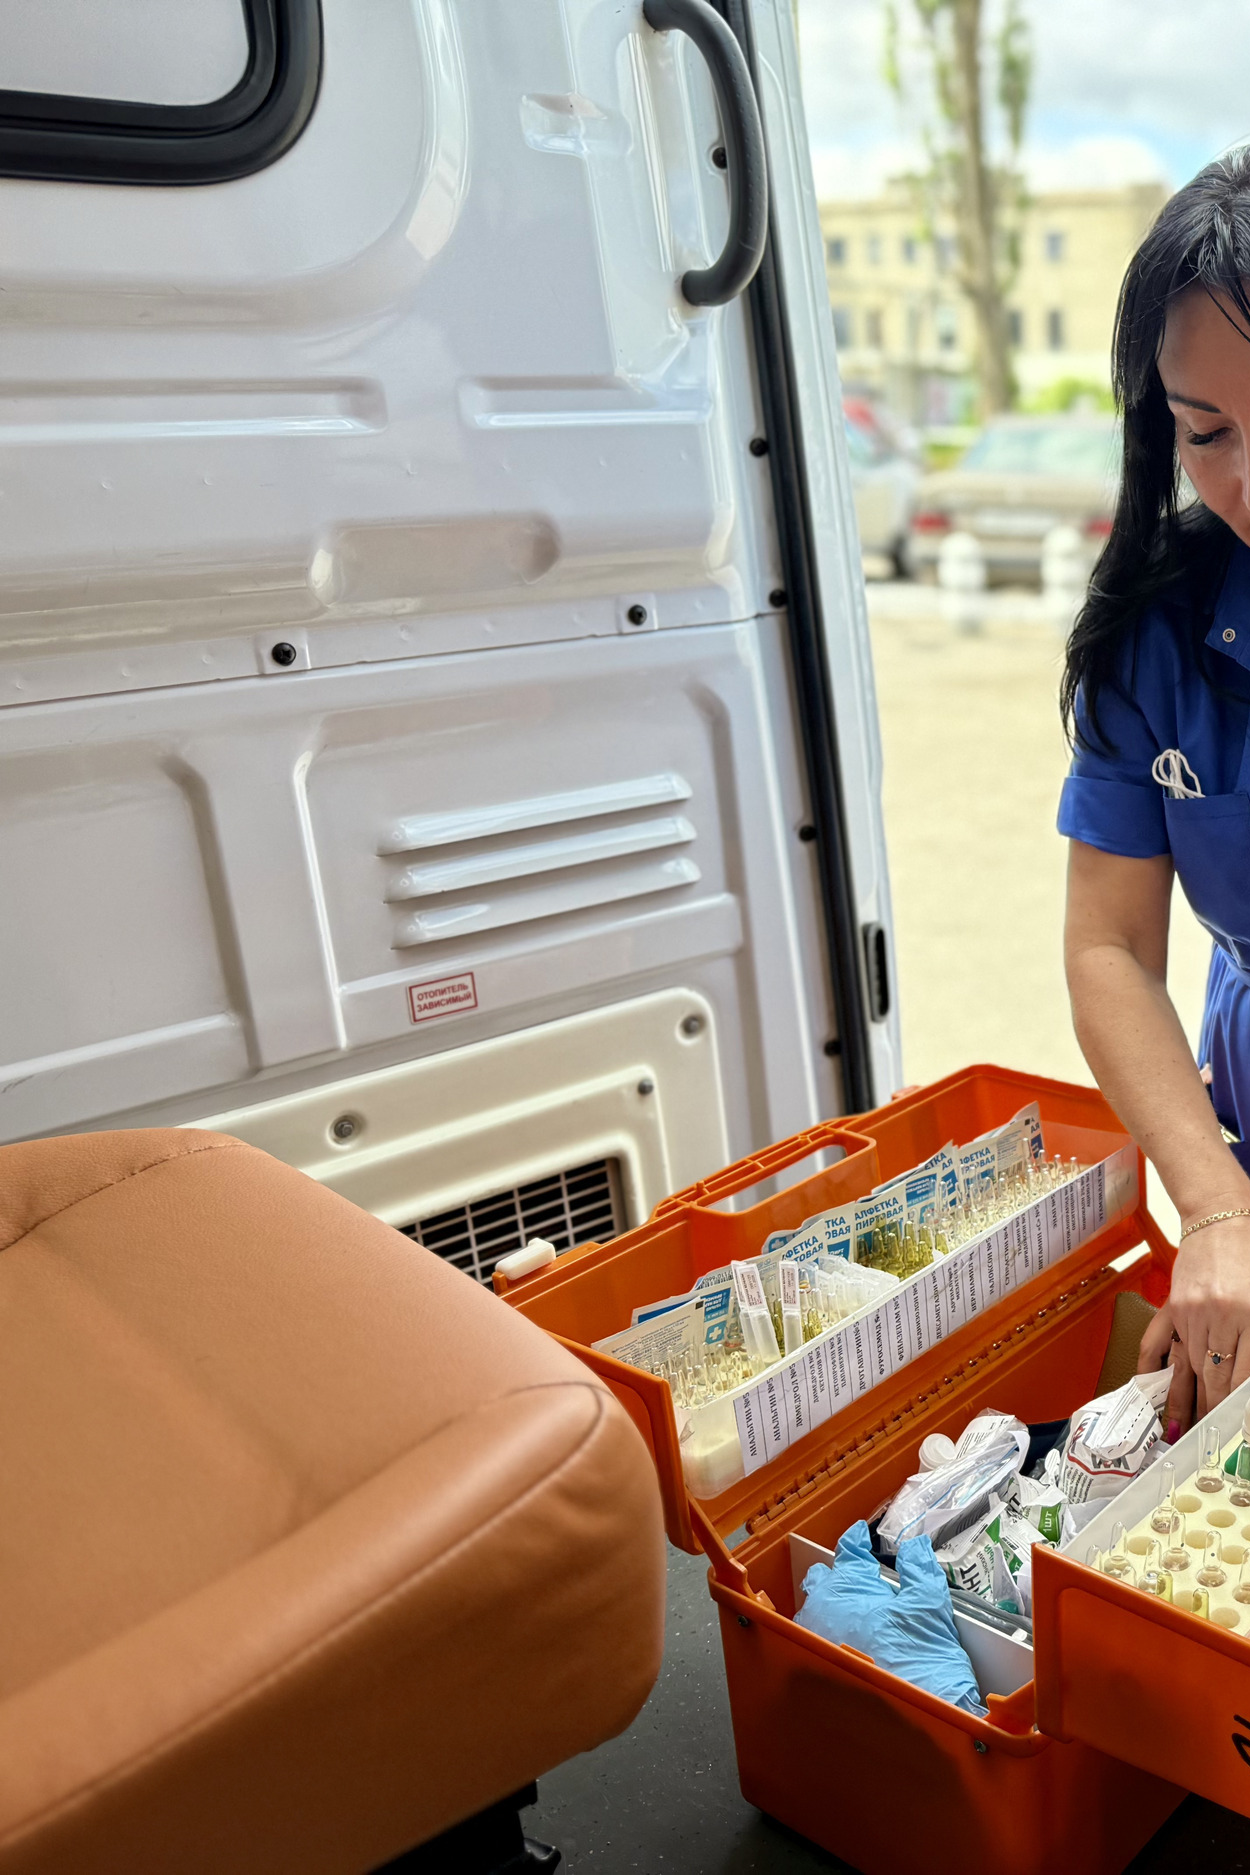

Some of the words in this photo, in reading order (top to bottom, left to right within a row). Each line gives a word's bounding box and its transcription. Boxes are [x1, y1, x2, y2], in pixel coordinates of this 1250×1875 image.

[416, 983, 469, 1002] ОТОПИТЕЛЬ
[416, 990, 472, 1013] ЗАВИСИМЫЙ
[854, 1196, 900, 1221] АЛФЕТКА
[782, 1235, 819, 1261] ФЕТКА
[968, 1262, 976, 1311] ВЕРАПАМИЛ
[894, 1310, 904, 1361] ФЕНАЗЕПАМ
[913, 1295, 922, 1349] ПРЕДНИЗОЛОН
[932, 1284, 942, 1340] ДЕКСАМЕТАЗОН
[830, 1349, 839, 1397] КЕТОПРОФЕН
[837, 1345, 846, 1387] ПАПАВЕРИН
[875, 1323, 885, 1375] ФУРОСЕМИД
[791, 1378, 802, 1428] ДИМЕДРОЛ
[809, 1364, 819, 1403] ДИМЕДРОЛ
[745, 1407, 757, 1457] АНАЛЬГИН
[769, 1393, 781, 1442] АНАЛЬГИН
